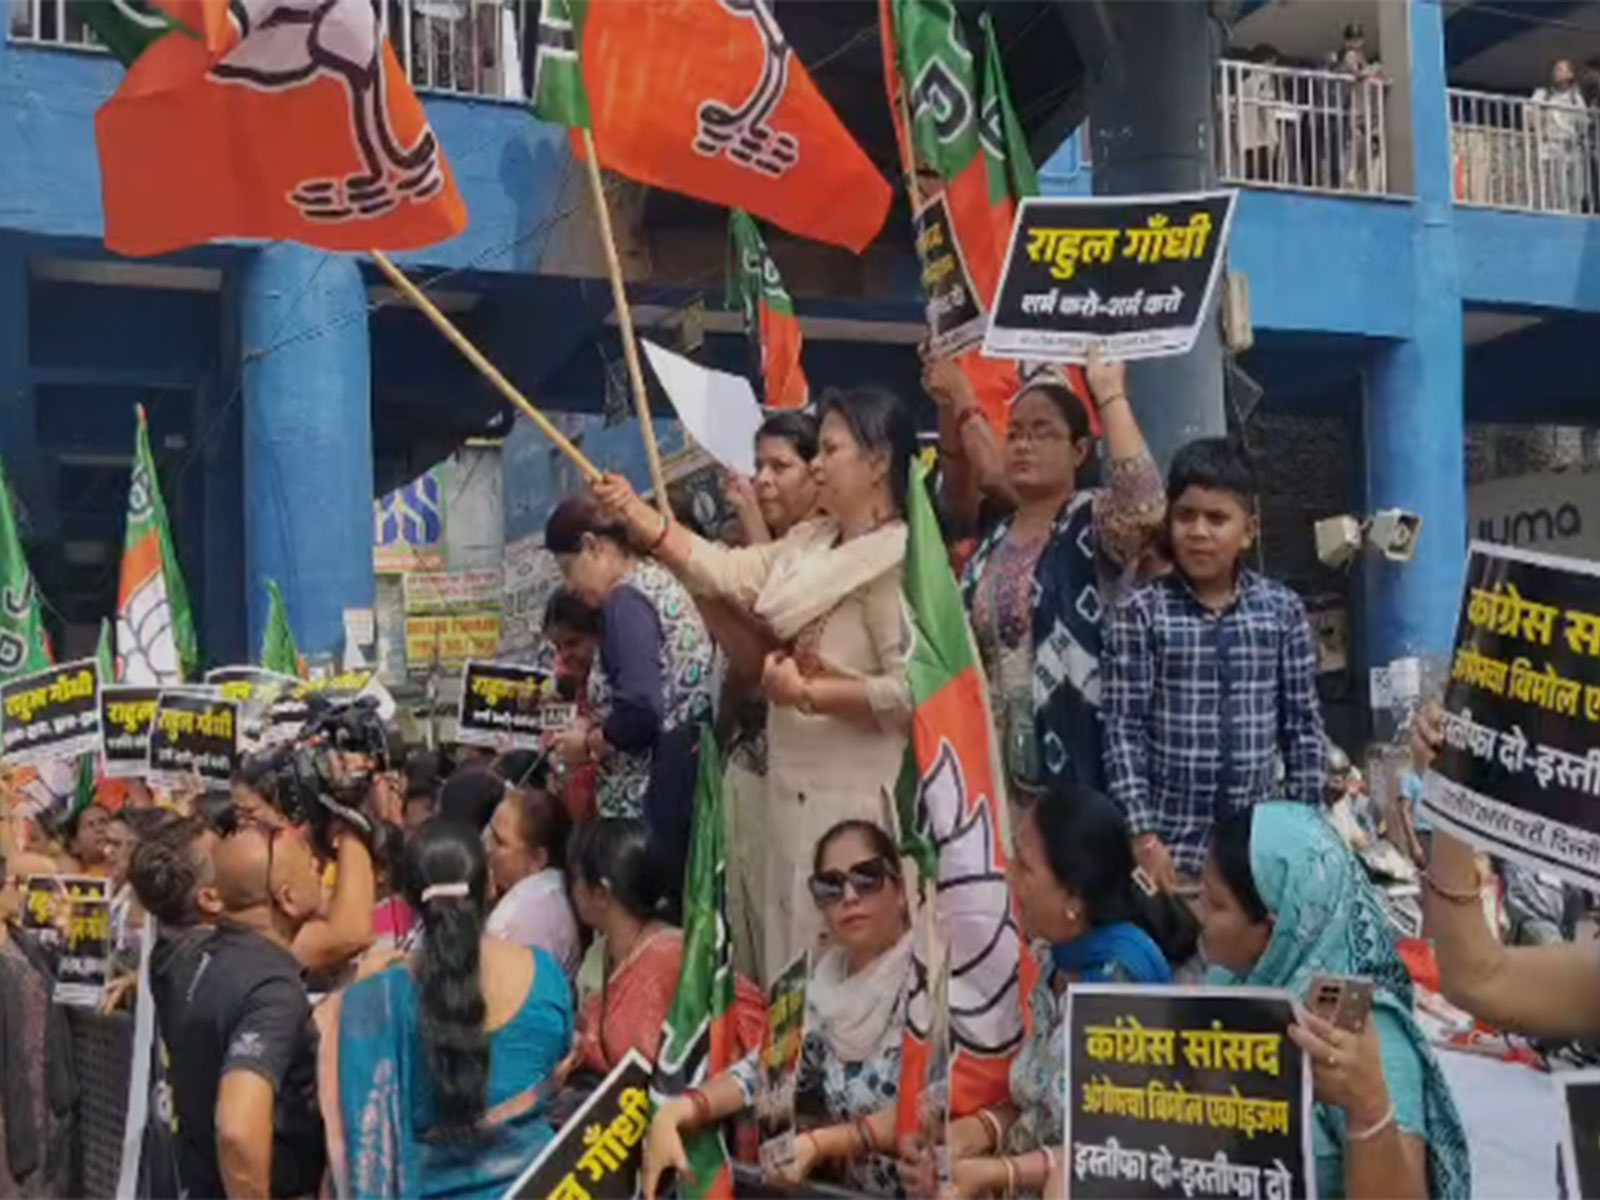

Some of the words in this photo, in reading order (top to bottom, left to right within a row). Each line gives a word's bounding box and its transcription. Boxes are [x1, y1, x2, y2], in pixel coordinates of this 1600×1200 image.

[1026, 228, 1121, 280] राहुल
[1123, 212, 1212, 264] गाँधी
[1468, 581, 1560, 646] कांग्रेस
[1084, 1014, 1176, 1066] कांग्रेस
[1181, 1020, 1282, 1076] सांसद
[575, 1087, 650, 1182] गाँधी
[1074, 1136, 1147, 1181] इस्तीफा
